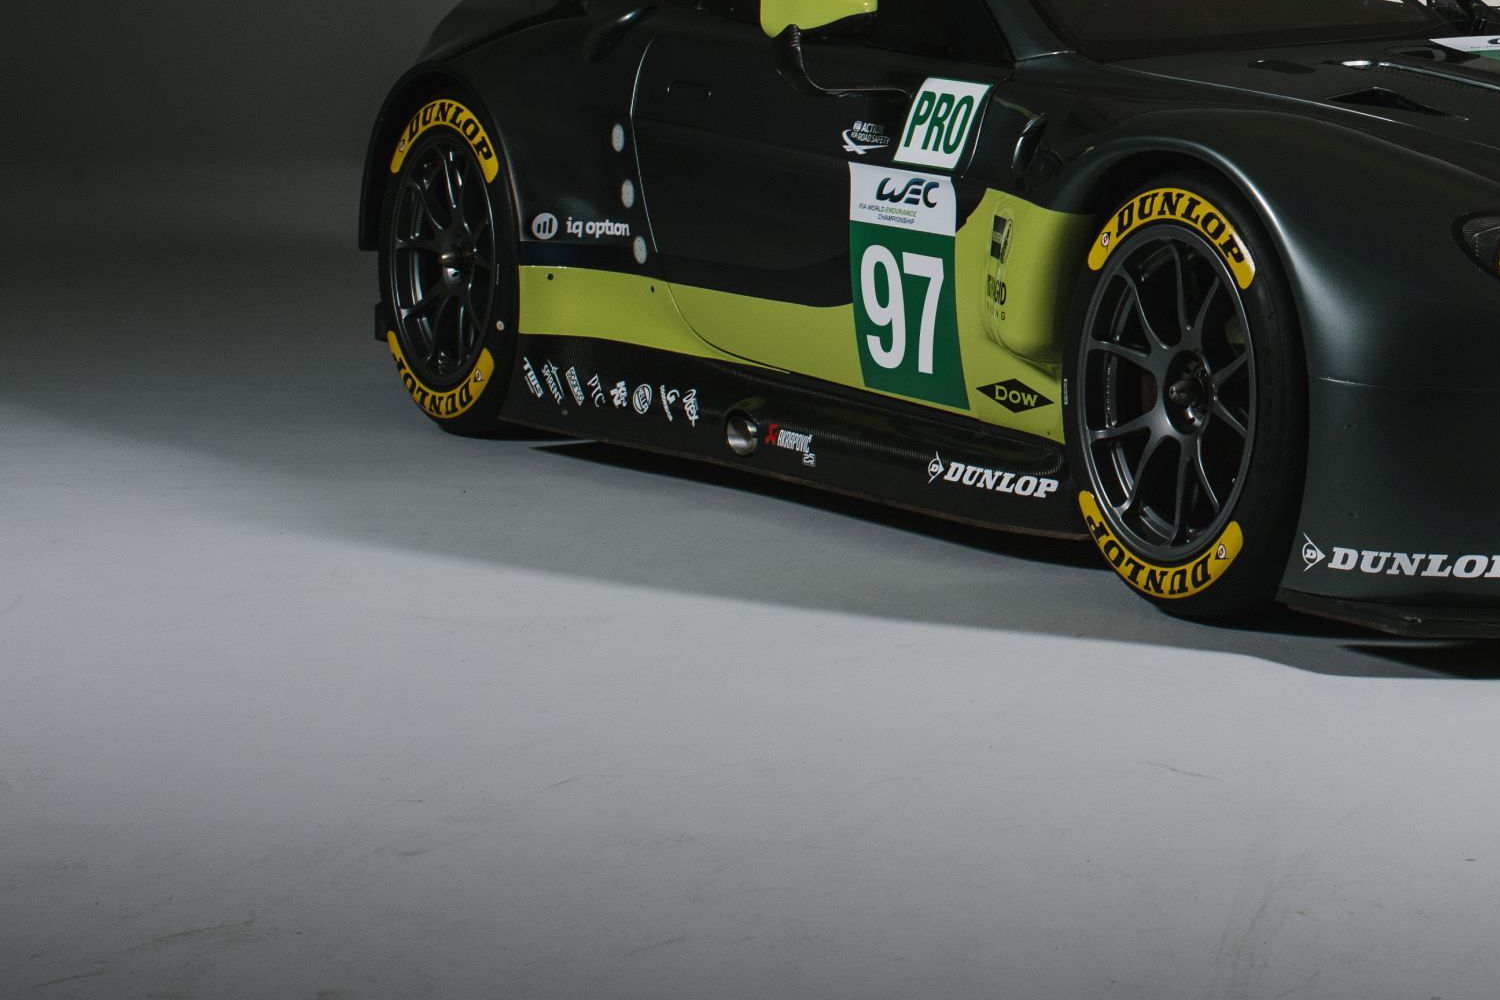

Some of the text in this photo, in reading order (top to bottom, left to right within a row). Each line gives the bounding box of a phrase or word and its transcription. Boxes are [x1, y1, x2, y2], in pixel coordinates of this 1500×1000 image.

[408, 102, 493, 160] DUNLOP
[871, 135, 892, 144] SAFETY
[904, 90, 975, 155] PRO
[868, 205, 884, 213] WORLD
[885, 207, 917, 217] ENDURANCE
[876, 177, 940, 208] WEC
[566, 216, 631, 239] iq option
[878, 214, 915, 225] CHAMPIONSHIP
[1115, 192, 1246, 263] DUNLOP
[860, 244, 945, 375] 97
[541, 364, 563, 405] SPIRENT
[944, 461, 1059, 498] DUNLOP
[1086, 515, 1212, 595] DUNLOP
